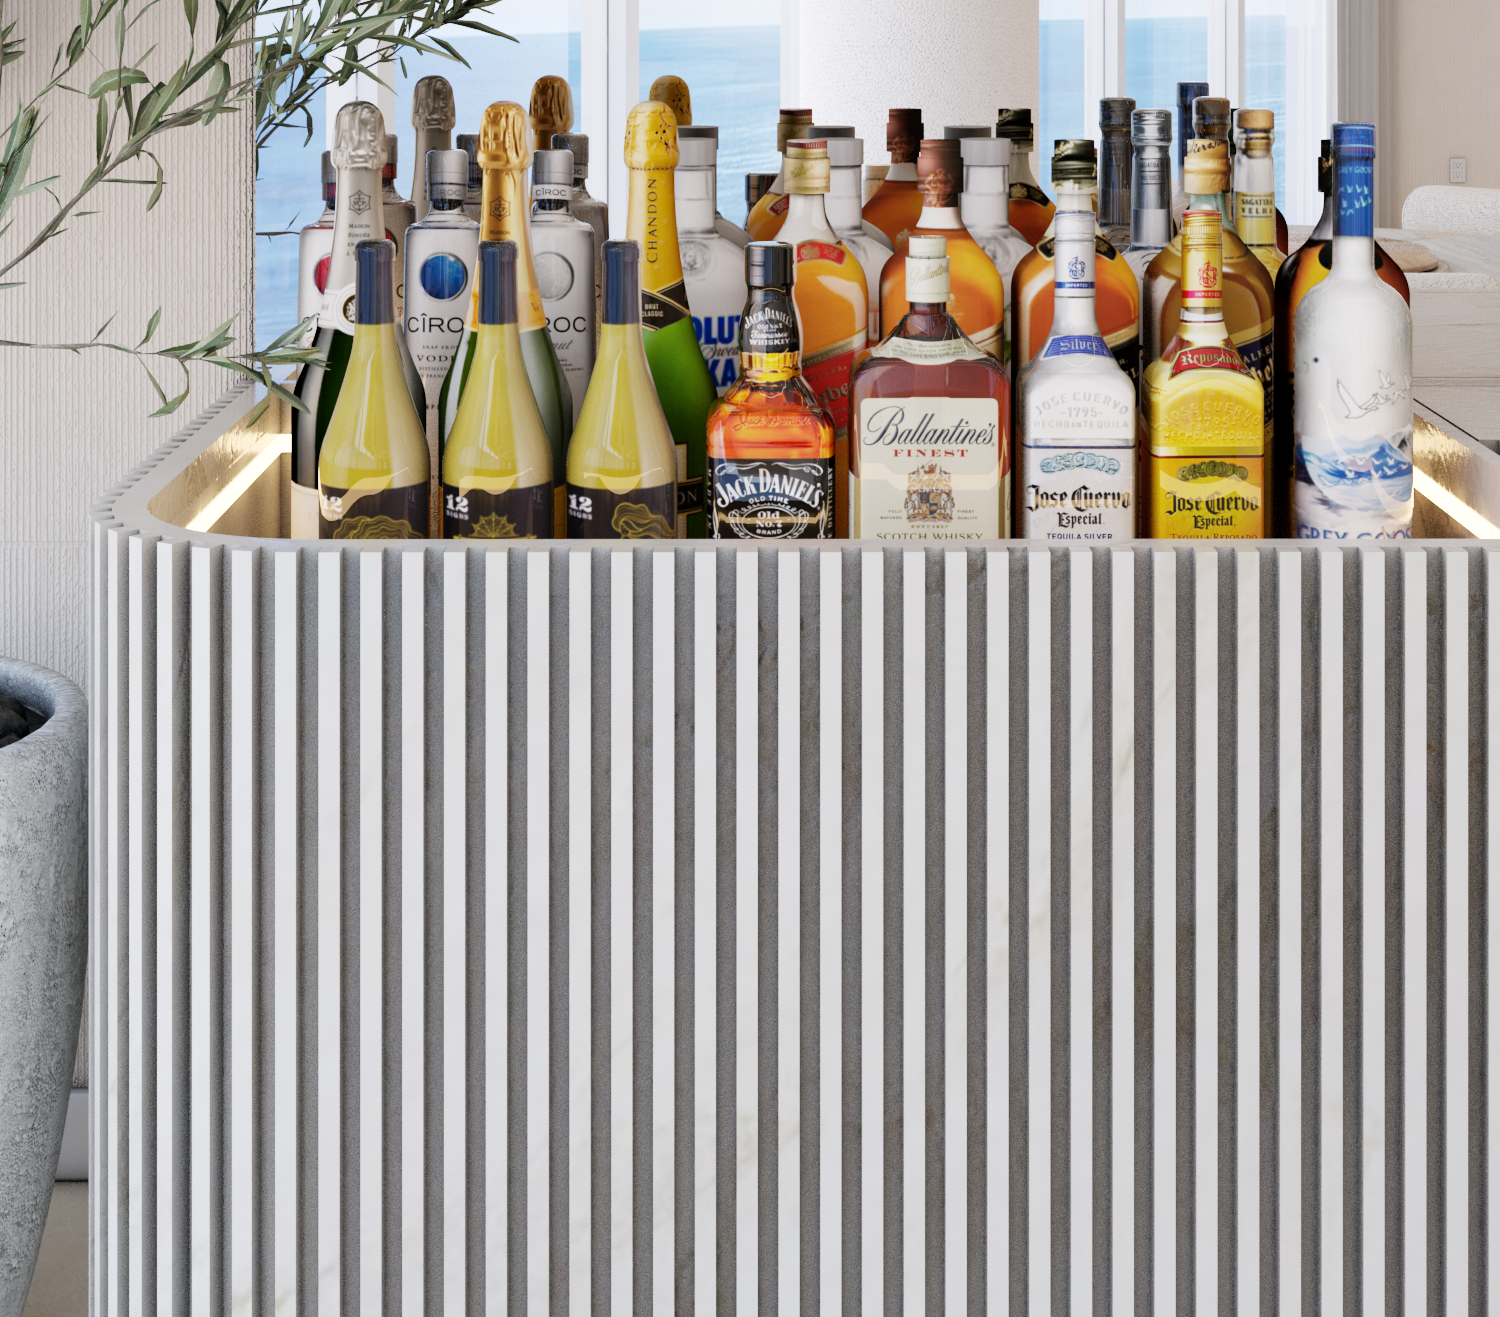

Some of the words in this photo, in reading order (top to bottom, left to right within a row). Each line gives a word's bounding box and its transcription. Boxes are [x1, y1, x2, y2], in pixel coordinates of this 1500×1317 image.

[646, 177, 659, 263] CHANDON
[407, 313, 464, 333] CÎRO
[745, 311, 764, 330] JACK
[749, 338, 791, 346] WHISKEY
[1059, 338, 1098, 351] Silver
[1181, 352, 1239, 366] Reposado
[1034, 392, 1070, 416] JOSE
[1072, 391, 1129, 416] CUERVO
[863, 405, 996, 446] Ballantine's
[1034, 419, 1071, 429] HECHO
[1083, 419, 1129, 429] TEQUILA
[893, 449, 969, 458] FINEST
[715, 475, 758, 508] JACK
[758, 468, 825, 508] DANIEL'S
[322, 495, 343, 512] 12
[445, 494, 469, 512] 12
[568, 494, 593, 513] 12
[748, 495, 766, 504] OLD
[768, 494, 790, 504] TIME
[1026, 484, 1068, 512] Jose
[1071, 484, 1131, 512] Cuervo
[1164, 490, 1203, 516] Jose
[1205, 490, 1259, 515] Cuervo
[445, 510, 470, 521] SIGNS
[757, 510, 780, 520] Old
[755, 520, 783, 528] No.7
[756, 528, 783, 536] BRAND
